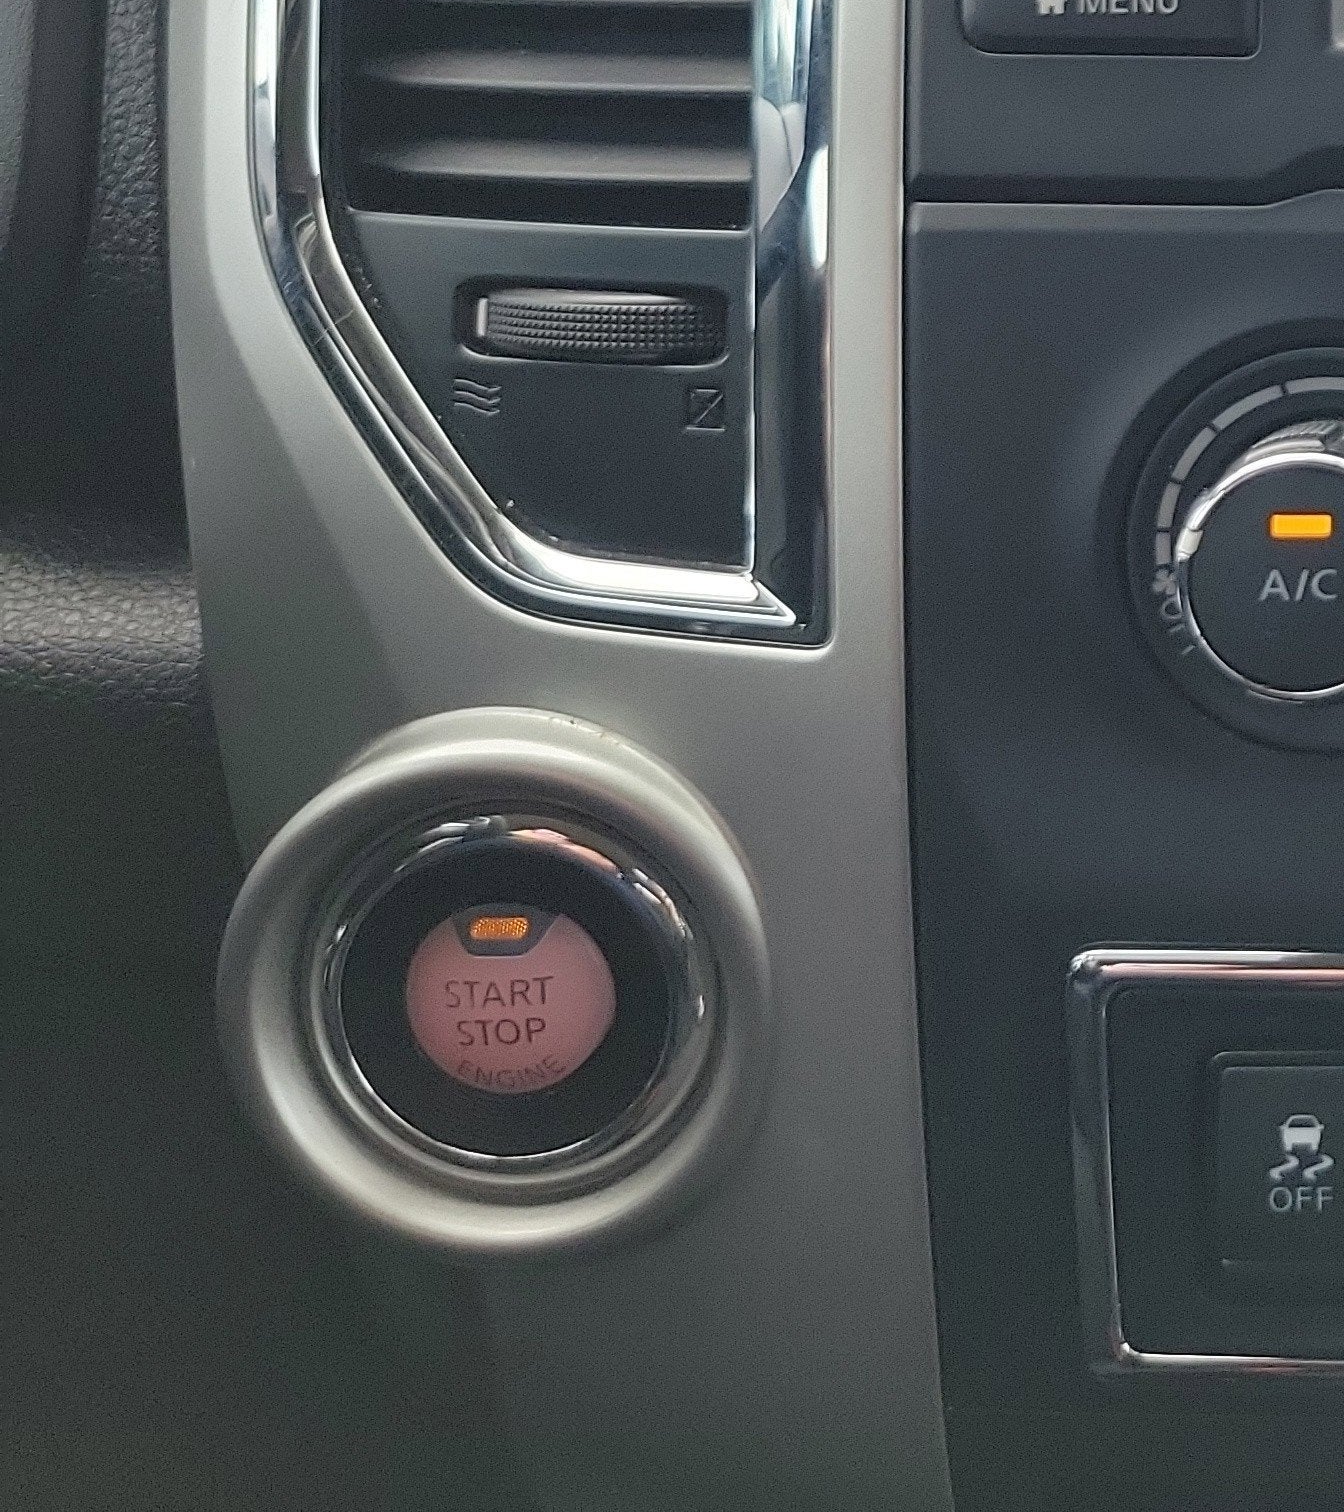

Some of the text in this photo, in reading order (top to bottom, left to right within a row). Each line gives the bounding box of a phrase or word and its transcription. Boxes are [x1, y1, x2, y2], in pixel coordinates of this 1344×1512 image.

[1258, 568, 1339, 602] A/C
[445, 975, 554, 1008] START
[456, 1017, 547, 1046] STOP
[458, 1053, 567, 1088] ENGINE
[1269, 1187, 1334, 1213] OFF
